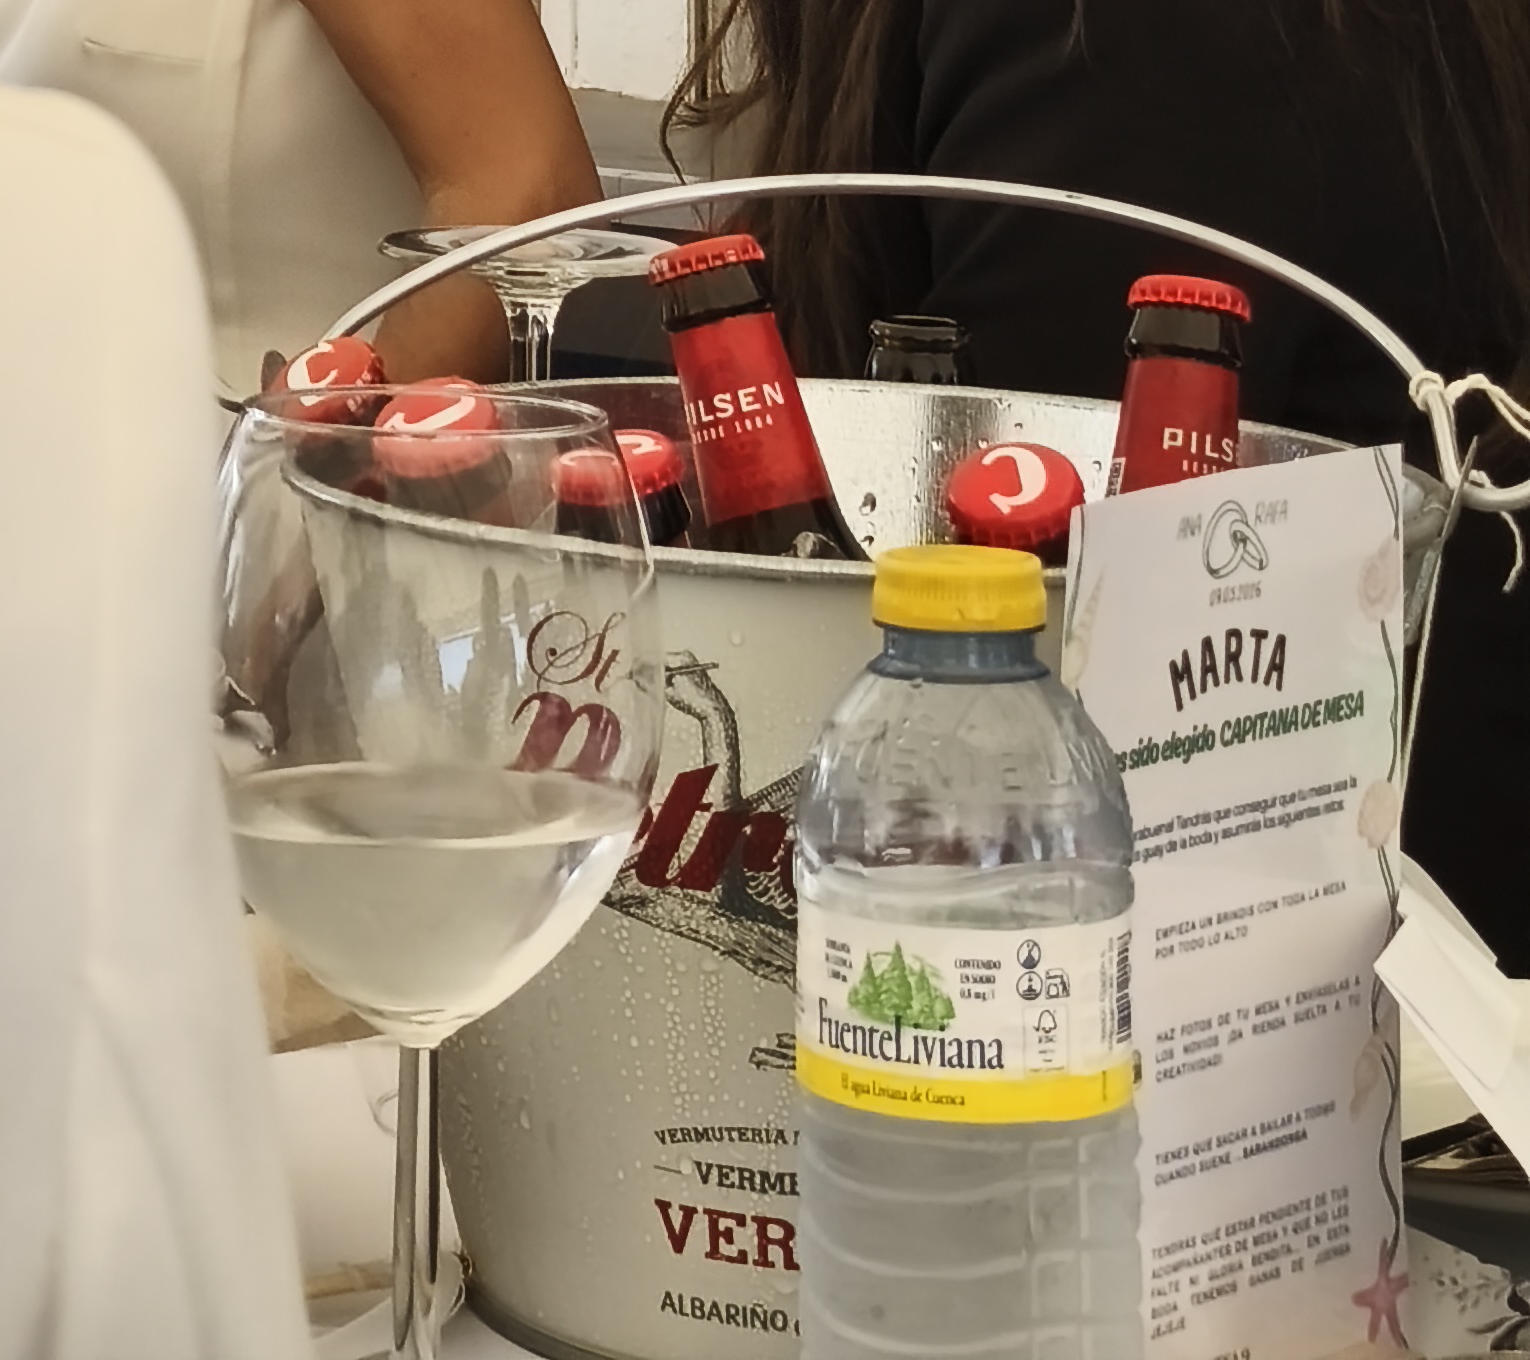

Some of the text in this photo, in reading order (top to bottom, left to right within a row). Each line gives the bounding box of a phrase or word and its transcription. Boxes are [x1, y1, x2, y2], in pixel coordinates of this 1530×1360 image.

[1169, 627, 1288, 713] MARTA
[1128, 736, 1160, 770] sido
[1160, 723, 1215, 764] elegido
[1219, 704, 1299, 748] CAPITANA
[1322, 689, 1364, 725] MESA
[1322, 881, 1346, 896] MESA
[1254, 1000, 1280, 1016] MESA
[818, 996, 1005, 1070] FuenteLiviana
[850, 1078, 871, 1098] agua
[872, 1079, 908, 1102] Liviana
[910, 1084, 923, 1103] de
[925, 1087, 966, 1107] Cuenca
[654, 1198, 801, 1271] VER
[1252, 1230, 1278, 1247] MESA
[660, 1290, 789, 1334] ALBARIÑO
